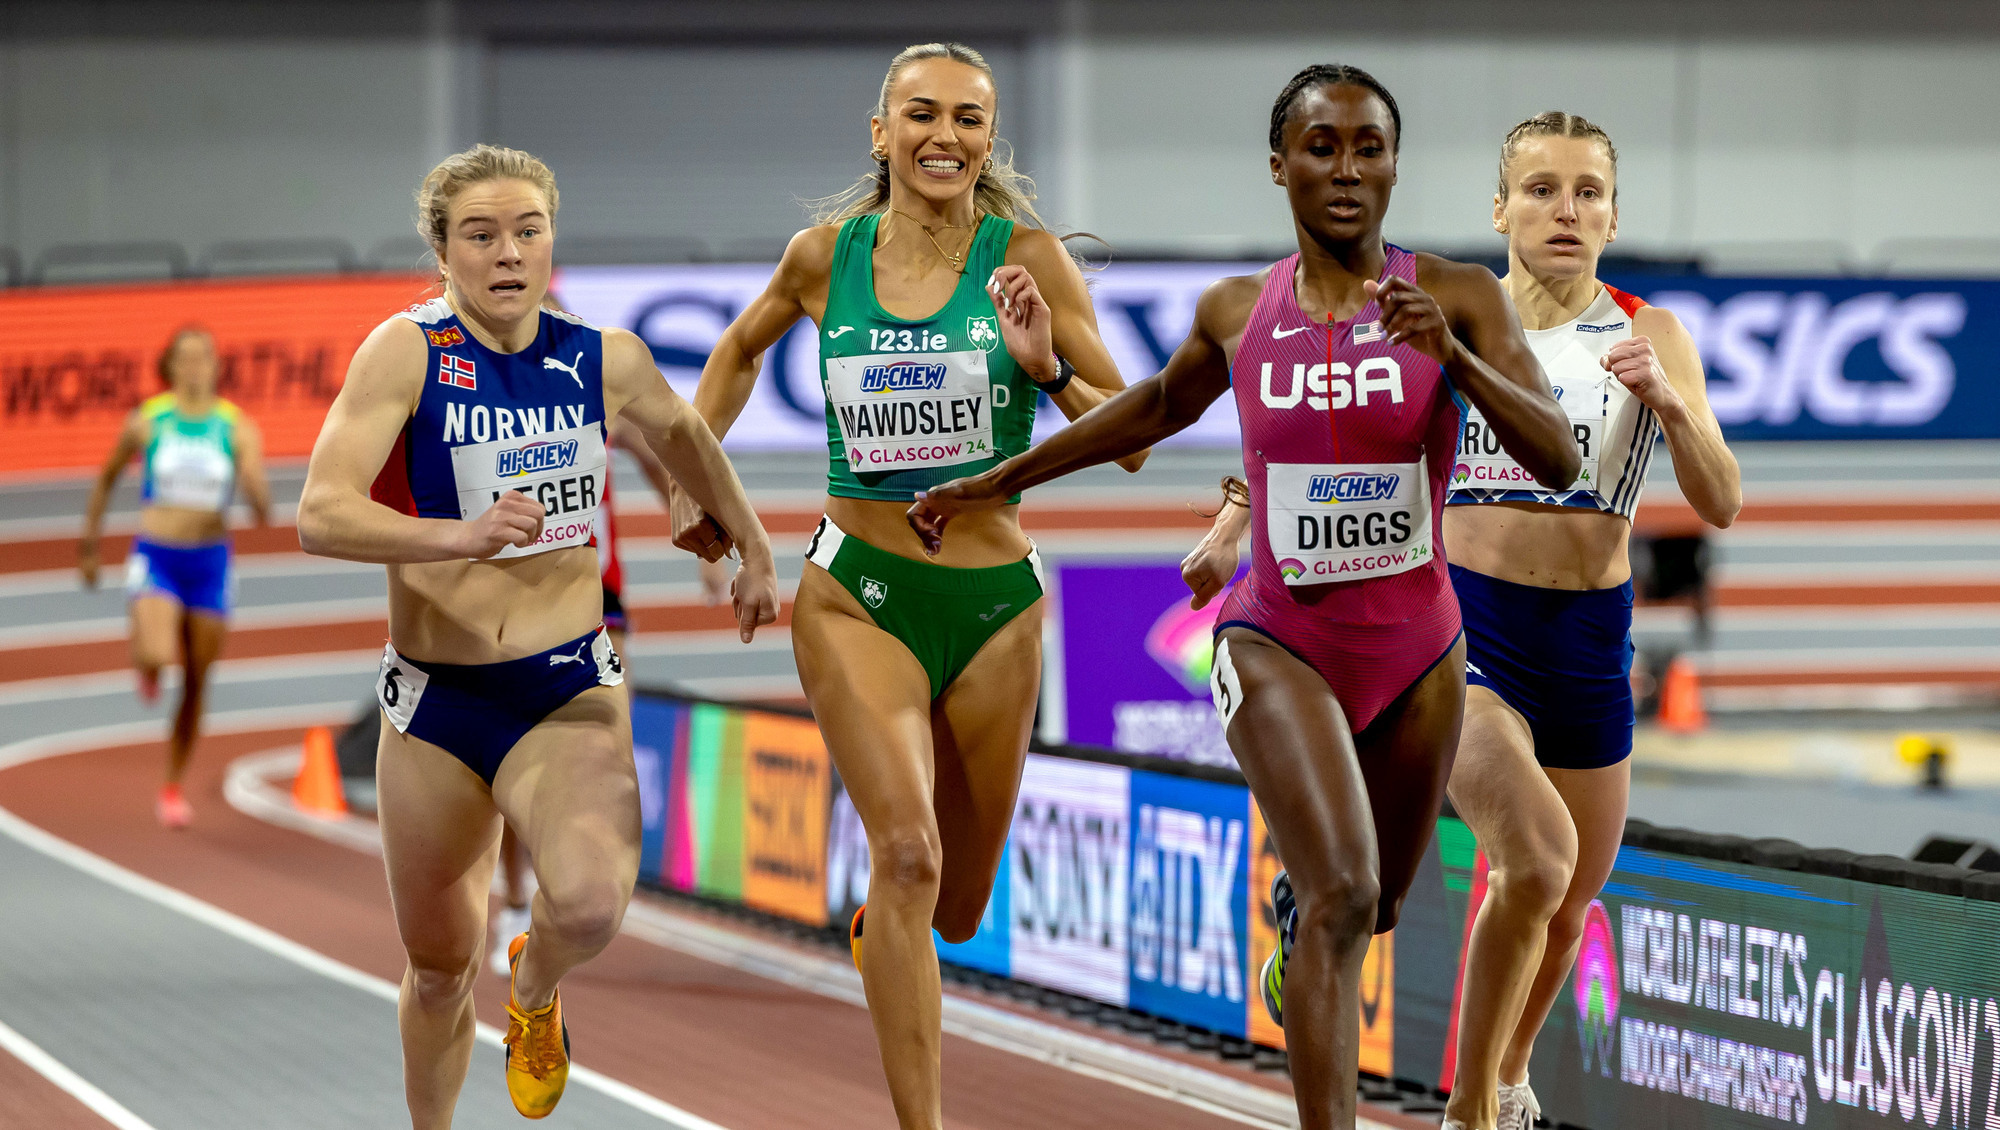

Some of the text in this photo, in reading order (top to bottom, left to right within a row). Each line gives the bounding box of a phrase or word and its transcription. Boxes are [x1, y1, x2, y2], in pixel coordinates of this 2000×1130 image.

[869, 329, 948, 351] 123.ie
[3, 347, 154, 420] WORL
[860, 363, 947, 393] HI-CHEW
[1260, 357, 1405, 411] USA
[443, 402, 585, 443] NORWAY
[840, 397, 982, 439] MAWDSLEY
[496, 439, 578, 477] HI-CHEW
[869, 439, 986, 464] GLASGOW 24
[1306, 473, 1399, 503] HI-CHEW
[1474, 466, 1534, 481] GLASG
[492, 474, 596, 517] GER
[528, 520, 591, 546] ASGOW
[1298, 511, 1411, 550] DIGGS
[1314, 544, 1428, 575] GLASGOW 24
[384, 667, 403, 707] 6
[1012, 800, 1127, 948] SONY
[1156, 807, 1244, 1003] TDK
[1621, 904, 1808, 1029] WORLD ATHLETICS
[1812, 966, 1978, 1130] GLASGOW
[1620, 1015, 1807, 1125] INDOOR CHAMPIONSHIPS
